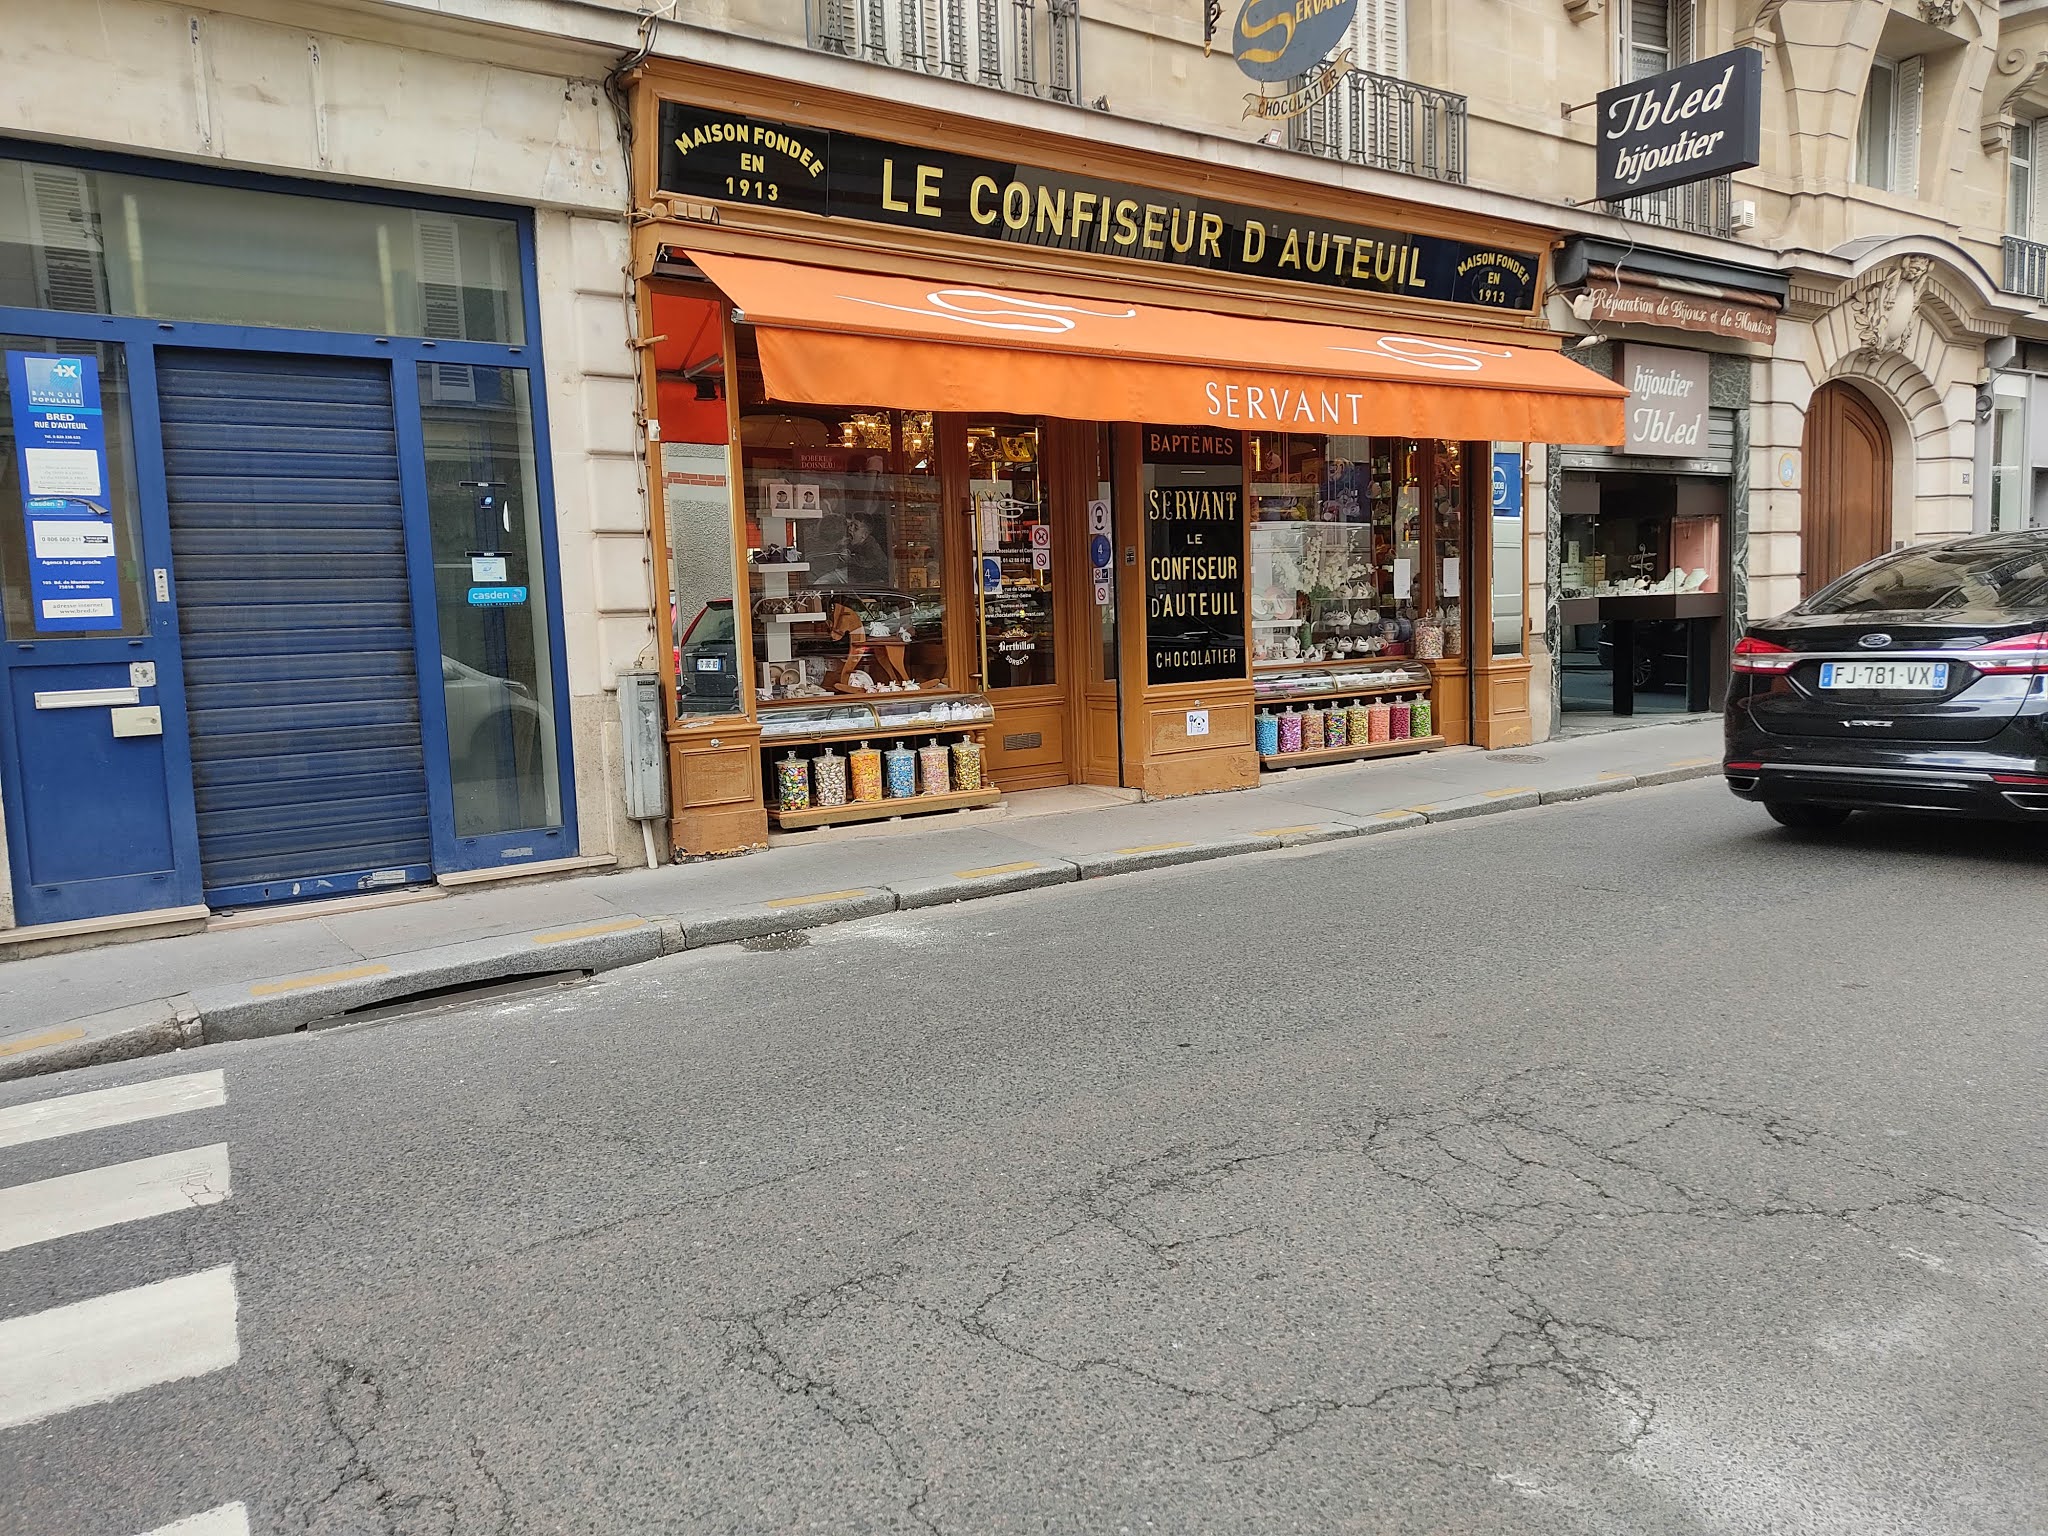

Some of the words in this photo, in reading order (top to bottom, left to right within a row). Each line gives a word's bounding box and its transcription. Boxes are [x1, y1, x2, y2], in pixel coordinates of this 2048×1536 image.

[1258, 69, 1339, 117] CHOCOLATIER
[674, 123, 749, 156] MAISON
[753, 126, 825, 178] FONDEE
[1614, 130, 1724, 184] bijoutier
[740, 152, 764, 173] EN
[725, 176, 779, 201] 1913
[882, 158, 944, 217] LE
[969, 175, 1224, 259] CONFISEUR
[1457, 252, 1496, 277] MAISON
[1496, 254, 1530, 286] FONDEE
[1487, 271, 1501, 285] EN
[1479, 288, 1505, 303] 1913
[1592, 288, 1654, 317] Réparation
[1656, 296, 1669, 315] de
[1670, 300, 1707, 325] Bijoux
[1710, 310, 1718, 323] et
[1720, 308, 1732, 327] de
[31, 390, 80, 398] BANQUE
[1633, 365, 1693, 401] bijoutier
[1205, 381, 1363, 425] SERVANT
[34, 421, 50, 429] RUE
[50, 421, 88, 430] D'AUTEUIL
[45, 413, 75, 421] BRED
[1151, 432, 1233, 456] BAPTÊMES
[1149, 489, 1237, 521] SERVANT
[1097, 543, 1104, 555] 4
[1187, 533, 1203, 545] LE
[984, 568, 991, 579] 4
[1151, 556, 1238, 581] CONFISEUR
[472, 590, 510, 600] casden
[1151, 592, 1238, 618] D'AUTEUIL
[1005, 653, 1030, 666] SORBETS
[1156, 648, 1236, 669] CHOCOLATIER
[1834, 666, 1931, 685] FJ-781-VX
[1933, 677, 1945, 687] 03
